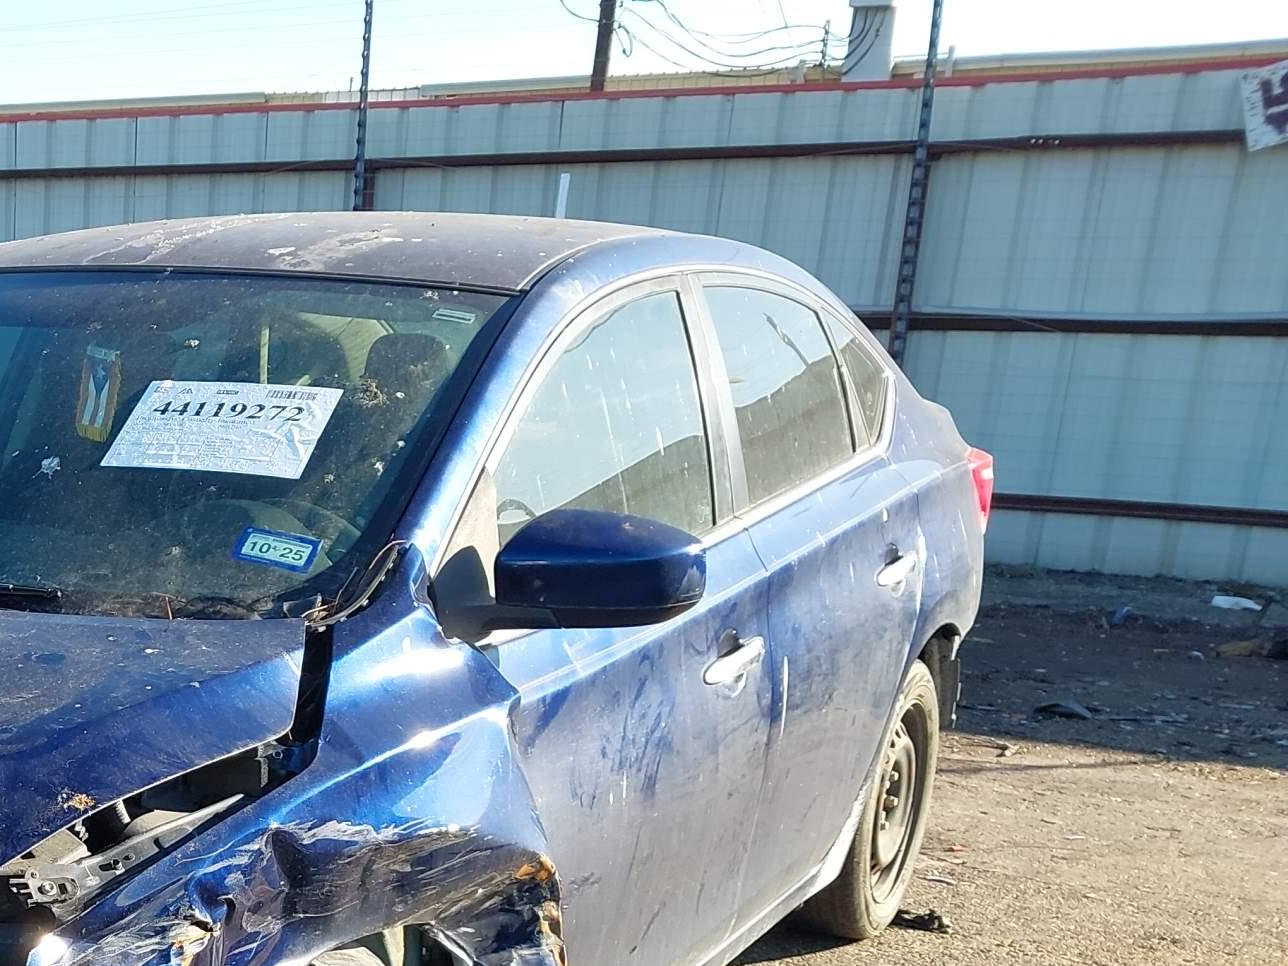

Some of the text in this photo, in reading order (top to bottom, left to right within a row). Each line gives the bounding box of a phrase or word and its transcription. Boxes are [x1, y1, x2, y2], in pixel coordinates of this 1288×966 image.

[152, 400, 305, 422] 44119272
[250, 540, 305, 561] 10 25
